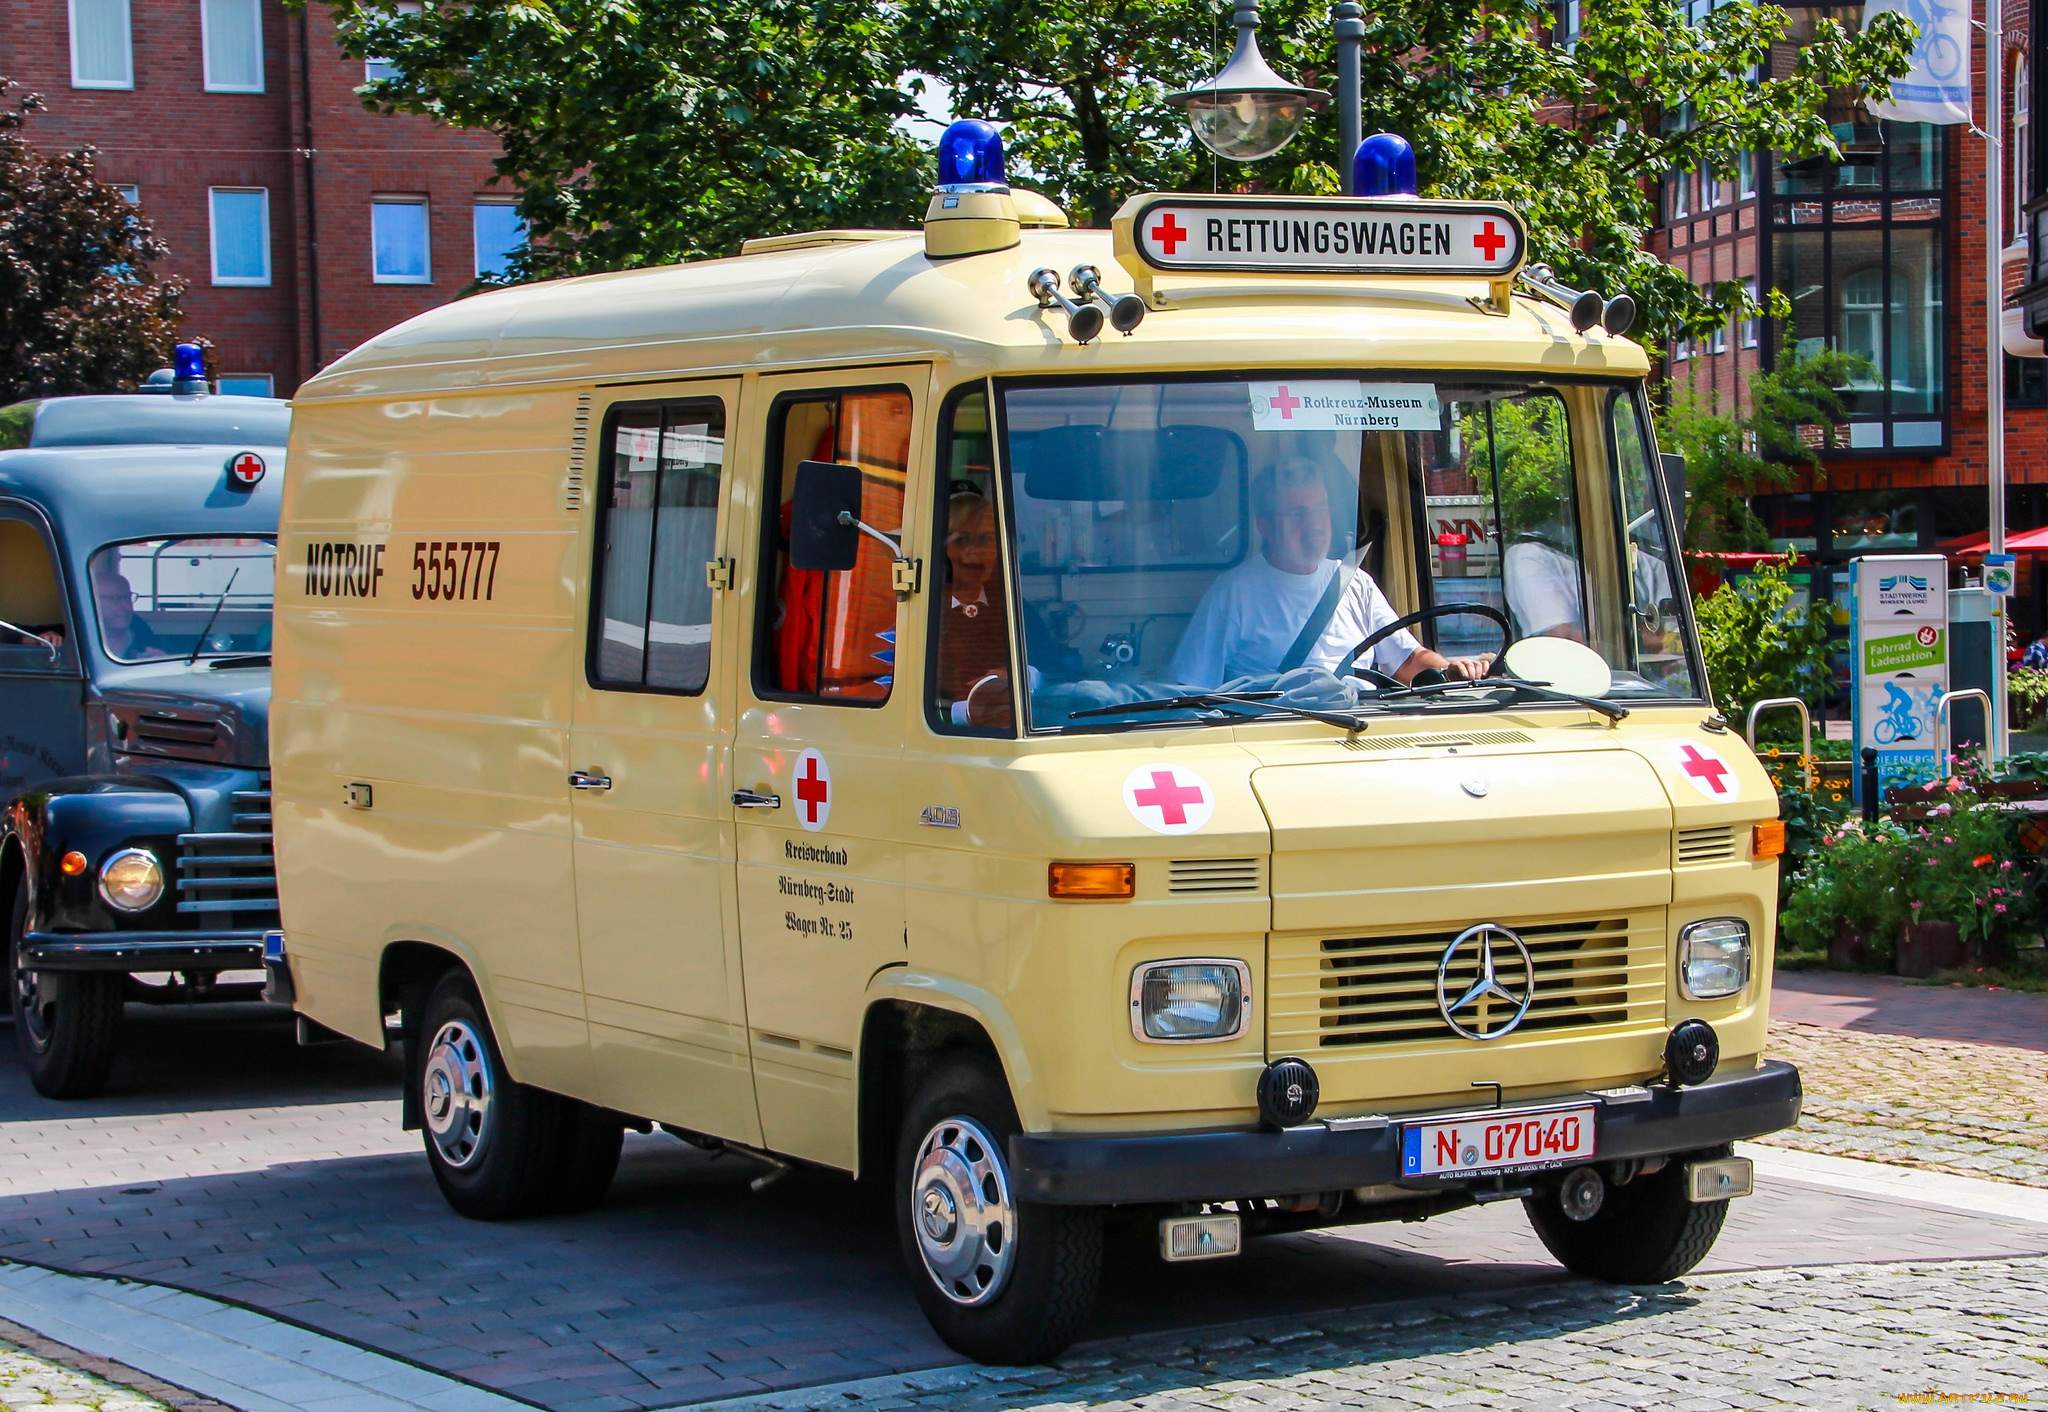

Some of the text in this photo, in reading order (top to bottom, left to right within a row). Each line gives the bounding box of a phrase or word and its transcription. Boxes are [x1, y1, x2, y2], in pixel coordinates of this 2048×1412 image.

[1206, 217, 1451, 256] RETTUNGSWAGEN
[1303, 394, 1423, 411] Rotkreuz-Museum
[1334, 412, 1399, 429] Nürnberg
[305, 541, 501, 601] NOTRUF 555777
[1870, 640, 1912, 656] Fahrrad
[1870, 650, 1933, 668] Ladestation
[919, 805, 961, 828] 408
[785, 839, 848, 867] Kreisverband
[778, 875, 854, 906] Nürnberg-Stadt
[784, 911, 853, 941] Wagen Nr. 25
[1436, 1116, 1580, 1167] N 07040
[1408, 1155, 1416, 1167] D
[1439, 1172, 1454, 1180] AUTO
